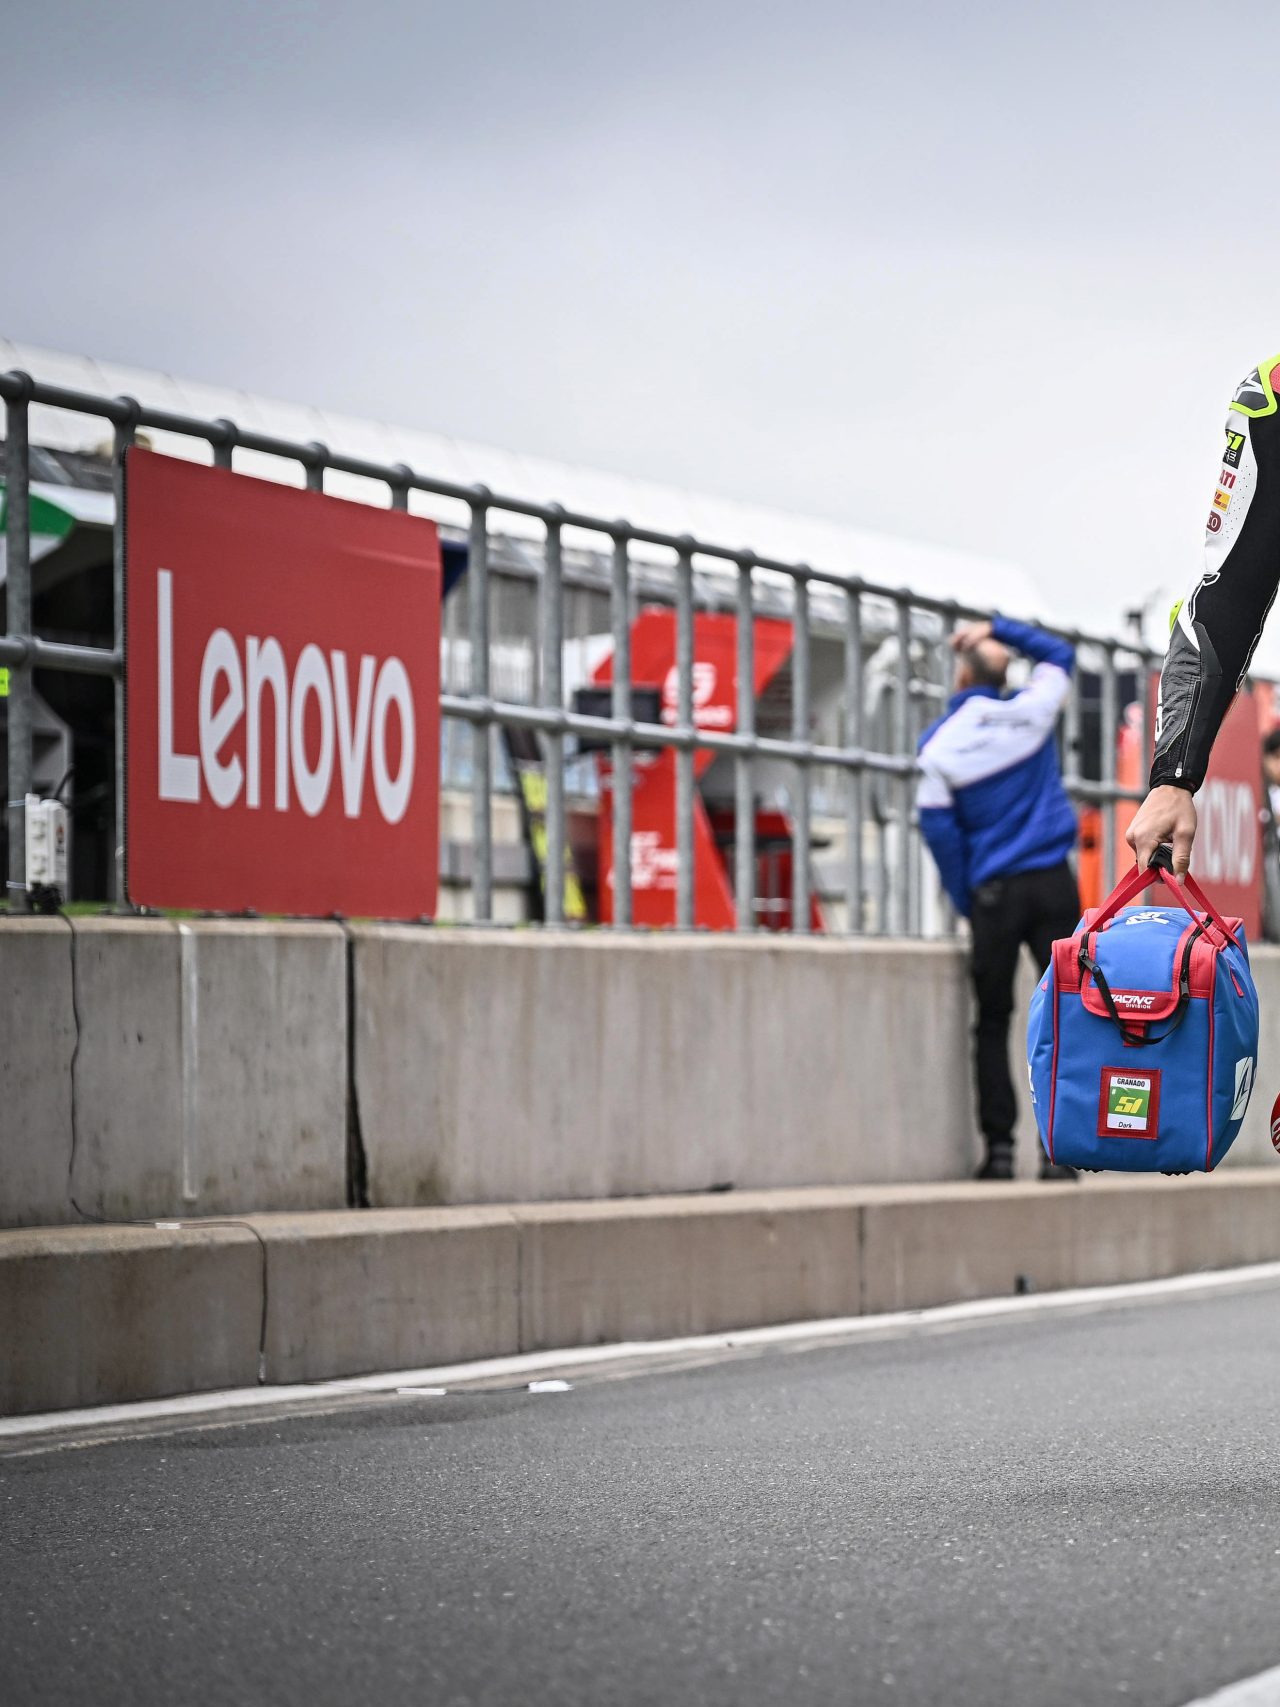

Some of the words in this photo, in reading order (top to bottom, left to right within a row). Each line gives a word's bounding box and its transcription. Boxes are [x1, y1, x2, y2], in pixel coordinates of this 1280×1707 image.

[157, 568, 416, 826] Lenovo
[1117, 1078, 1146, 1088] GRANADO
[1114, 1096, 1144, 1114] 51
[1118, 1121, 1133, 1129] Dark
